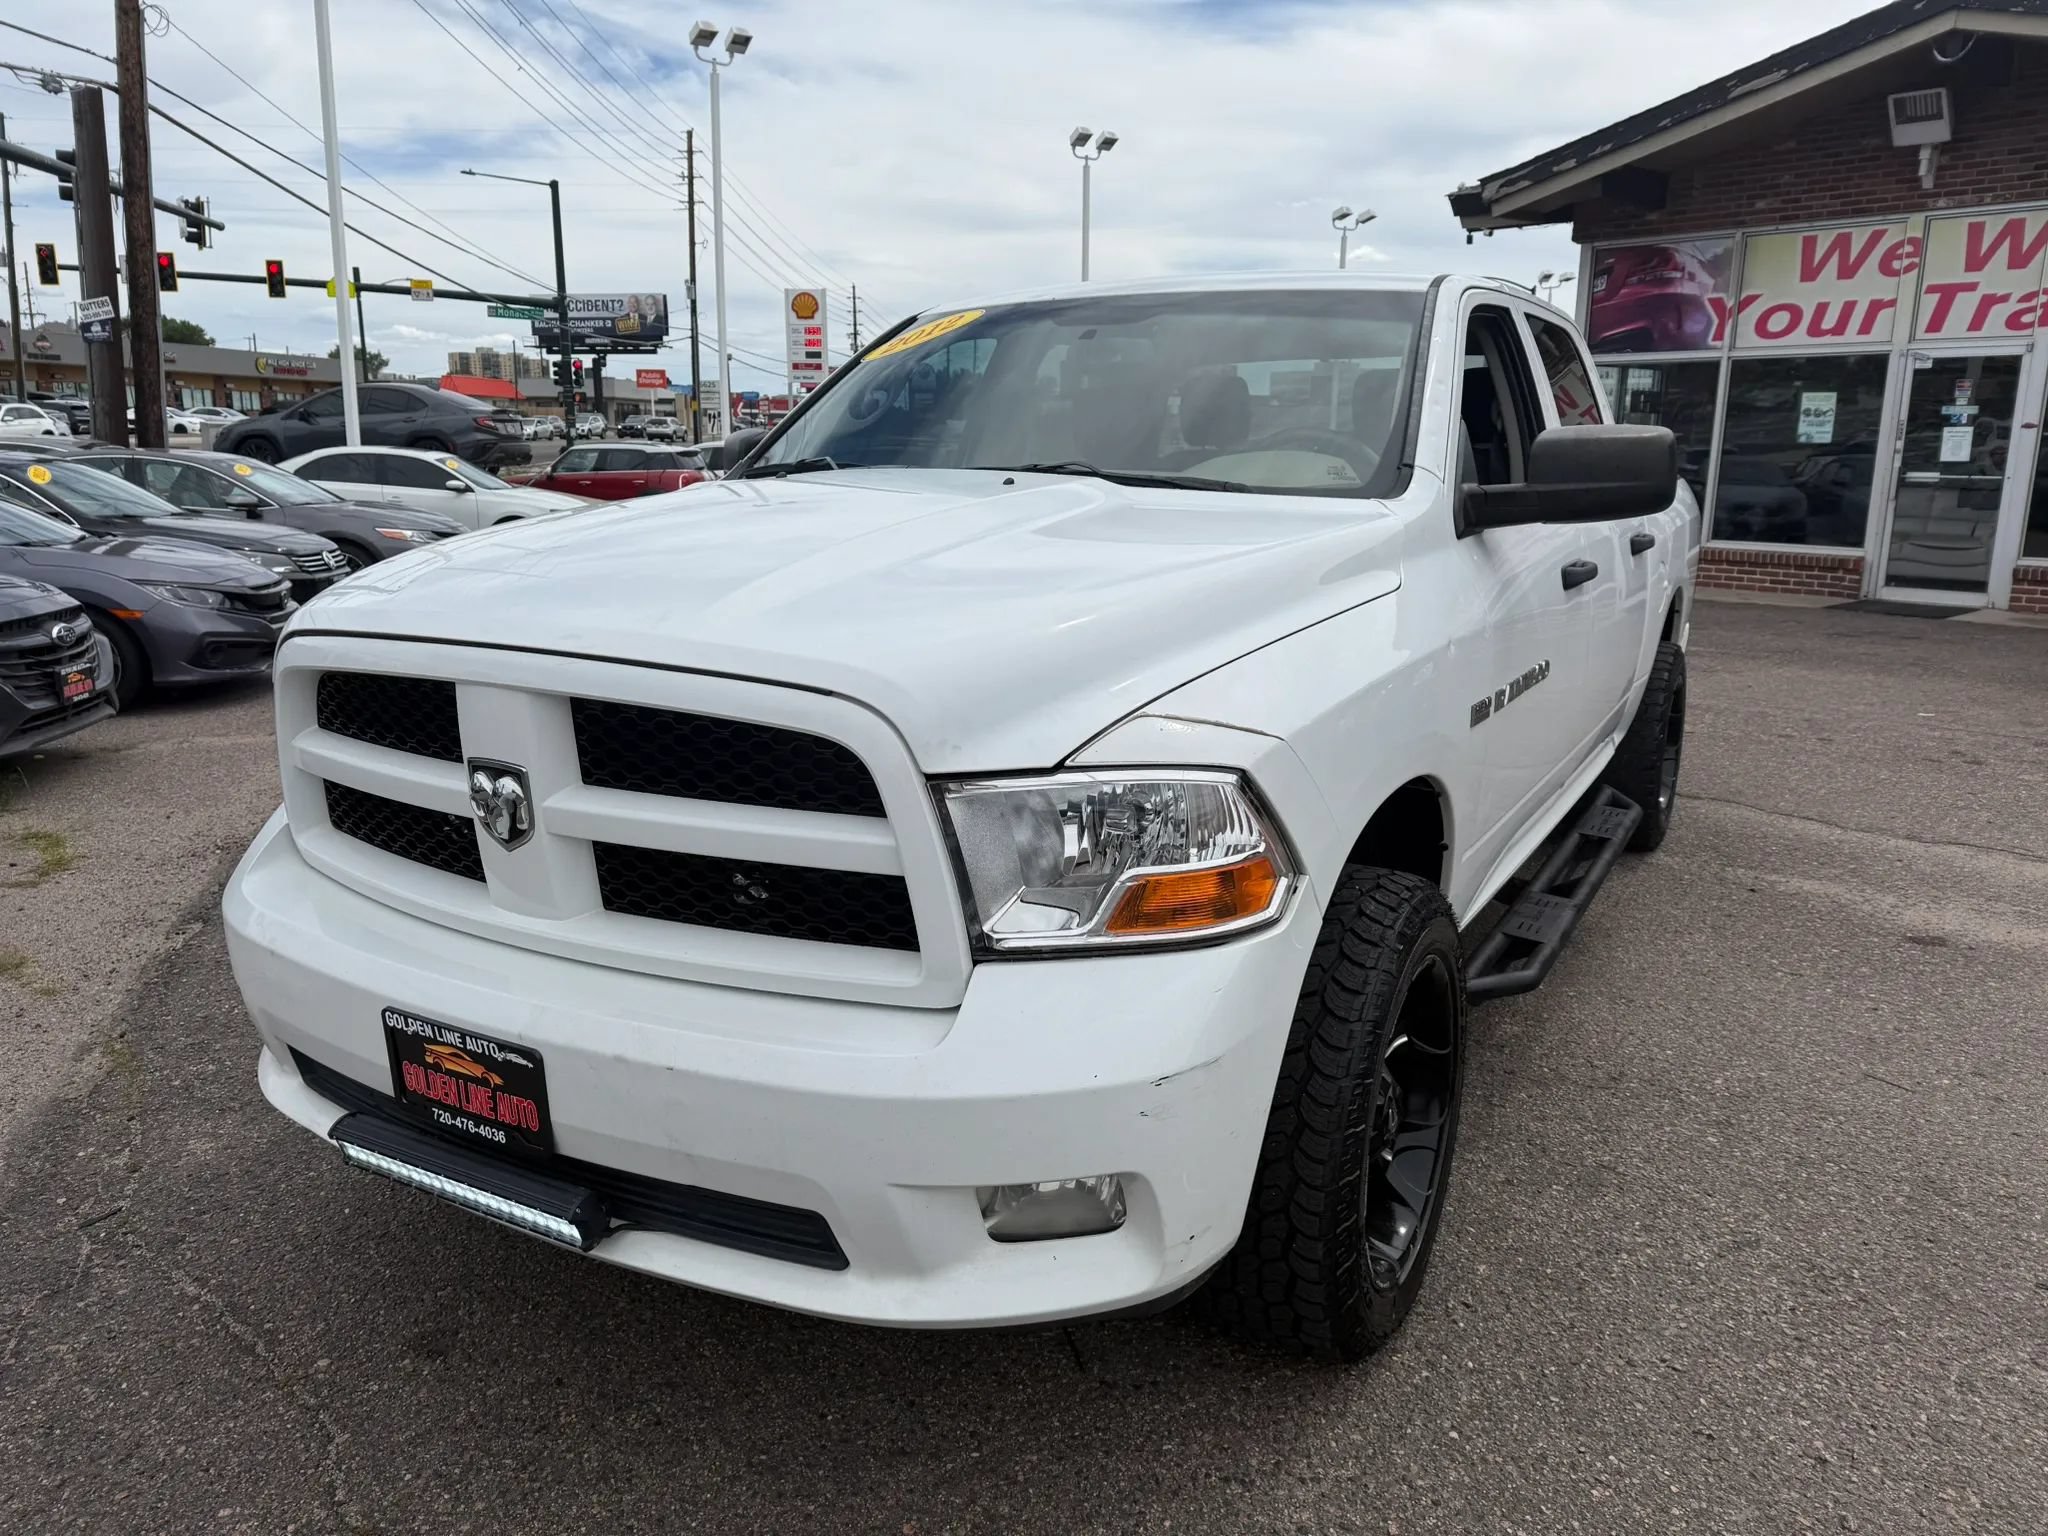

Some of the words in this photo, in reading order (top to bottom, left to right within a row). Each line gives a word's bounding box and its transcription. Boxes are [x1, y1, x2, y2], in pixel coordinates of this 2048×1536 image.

[1800, 228, 1922, 283] We
[80, 299, 110, 311] GUTTERS
[567, 299, 624, 312] CCIDENT?
[567, 320, 604, 328] CHANKER
[1707, 293, 1898, 343] Your
[880, 314, 966, 355] 2012
[385, 1011, 434, 1039] GOLDEN
[434, 1025, 464, 1048] LINE
[465, 1035, 499, 1060] AUTO
[402, 1060, 460, 1108] GOLDEN
[459, 1079, 495, 1119] LINE
[496, 1091, 539, 1132] AUTO
[432, 1107, 506, 1144] 720-476-4036
